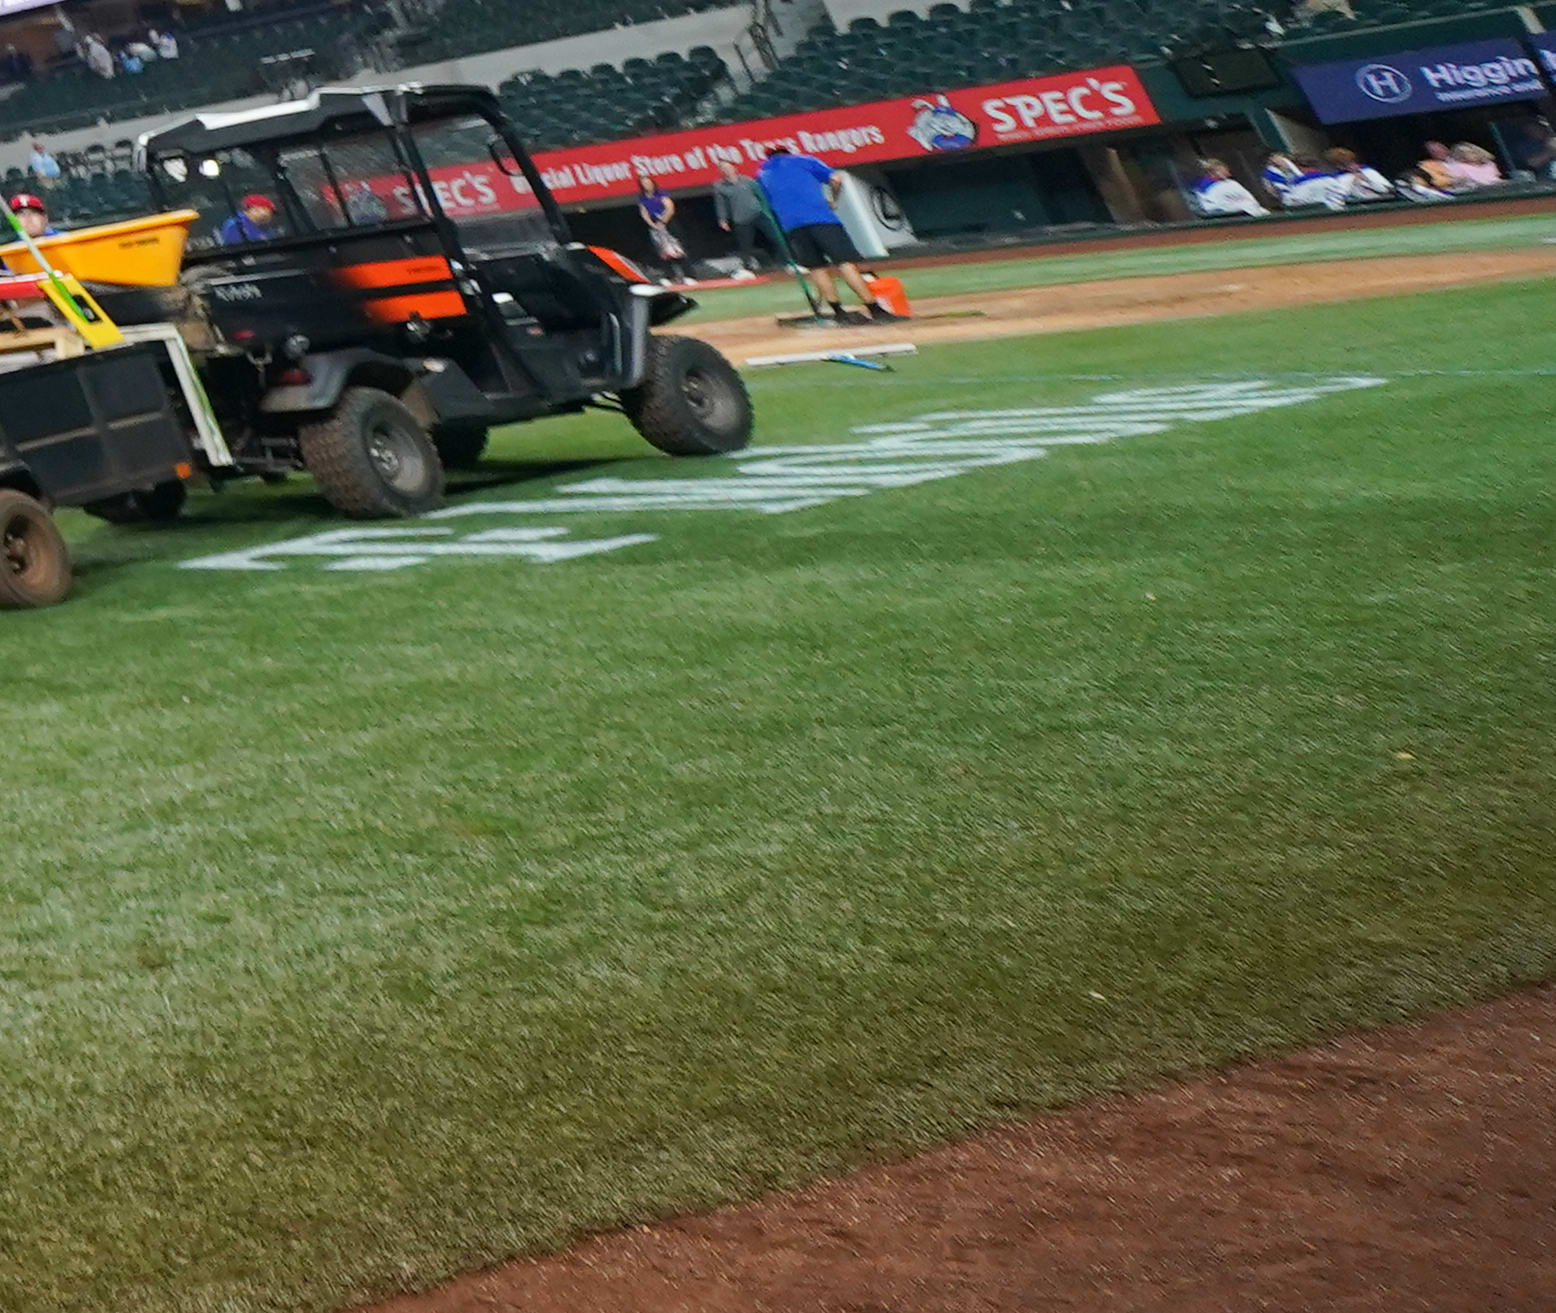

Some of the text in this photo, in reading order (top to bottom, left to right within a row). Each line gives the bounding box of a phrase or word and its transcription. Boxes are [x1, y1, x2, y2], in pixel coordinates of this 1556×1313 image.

[981, 77, 1137, 133] SPEC'S
[629, 153, 685, 176] Store
[683, 145, 708, 170] of
[796, 125, 885, 154] Rangers
